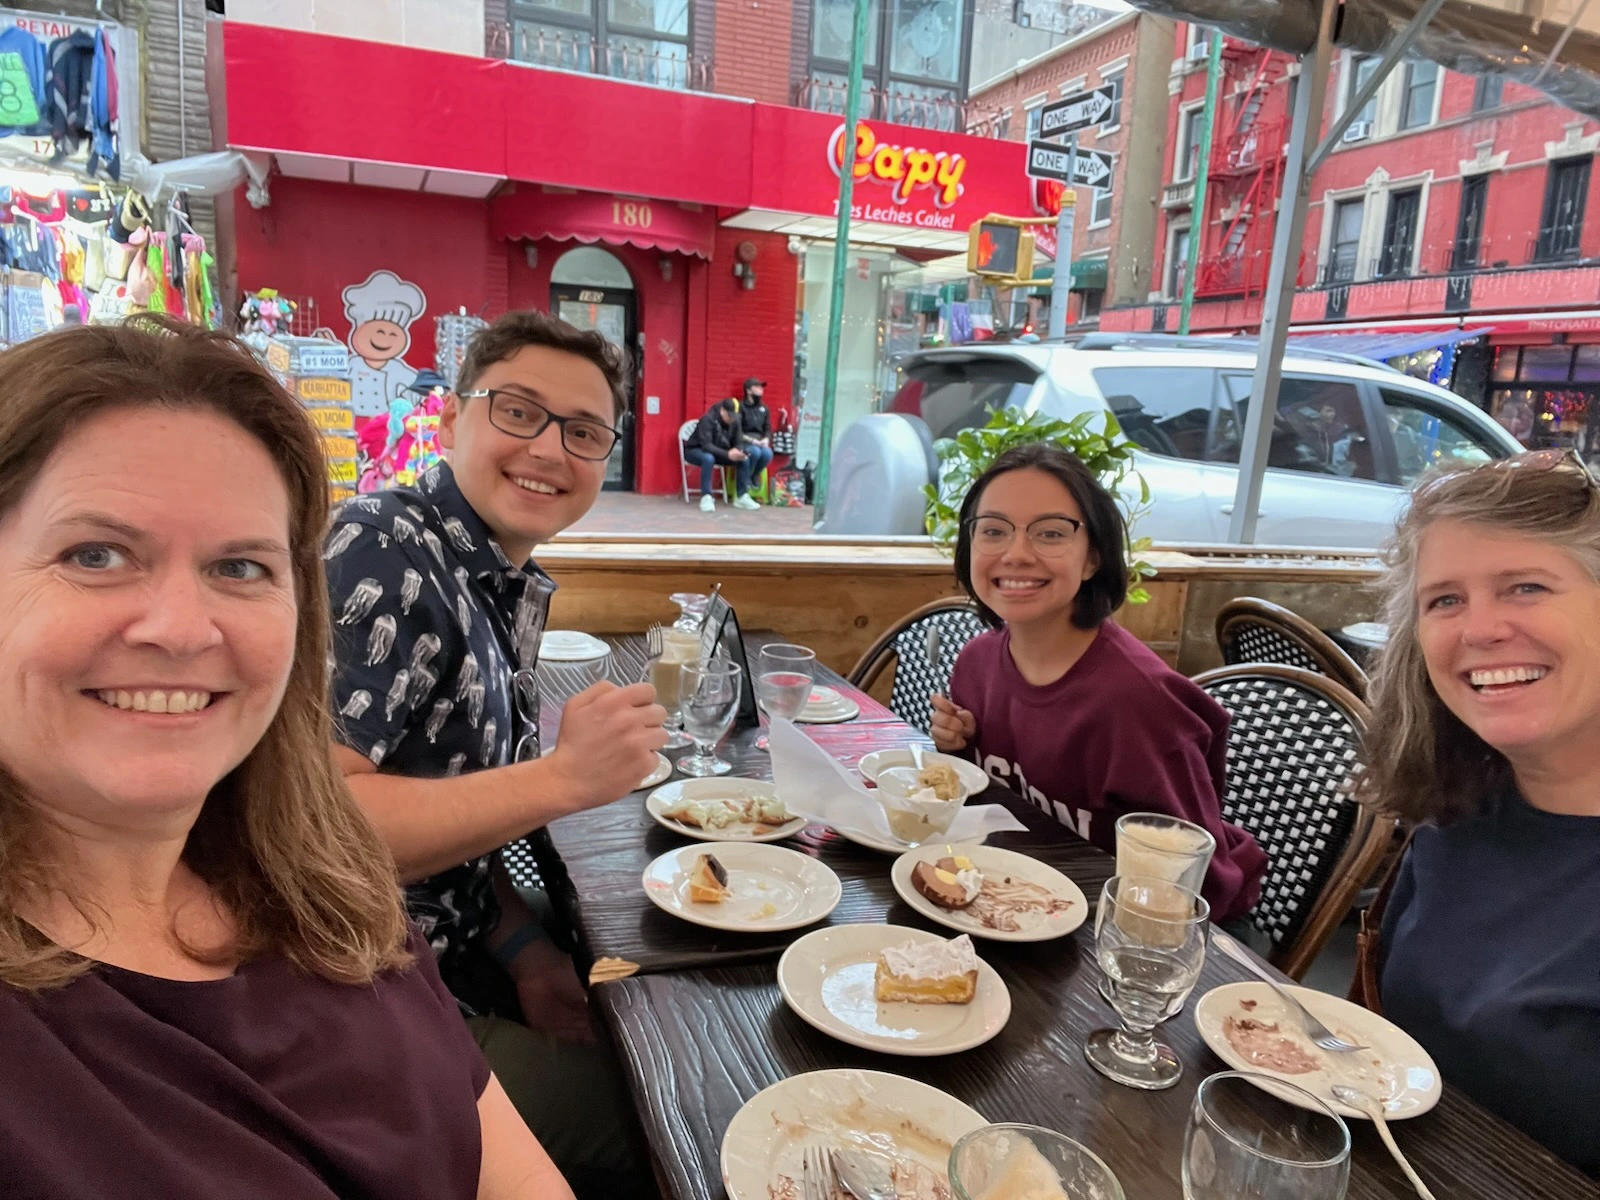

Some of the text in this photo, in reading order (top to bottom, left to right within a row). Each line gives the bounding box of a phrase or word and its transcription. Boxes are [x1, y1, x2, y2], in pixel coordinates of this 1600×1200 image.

[1045, 97, 1105, 128] ONE WAY
[1036, 152, 1104, 176] ONE WAY
[612, 201, 653, 229] 180
[833, 199, 955, 229] Tes Leches Cake!
[321, 357, 345, 367] MOM
[325, 412, 345, 423] MOM
